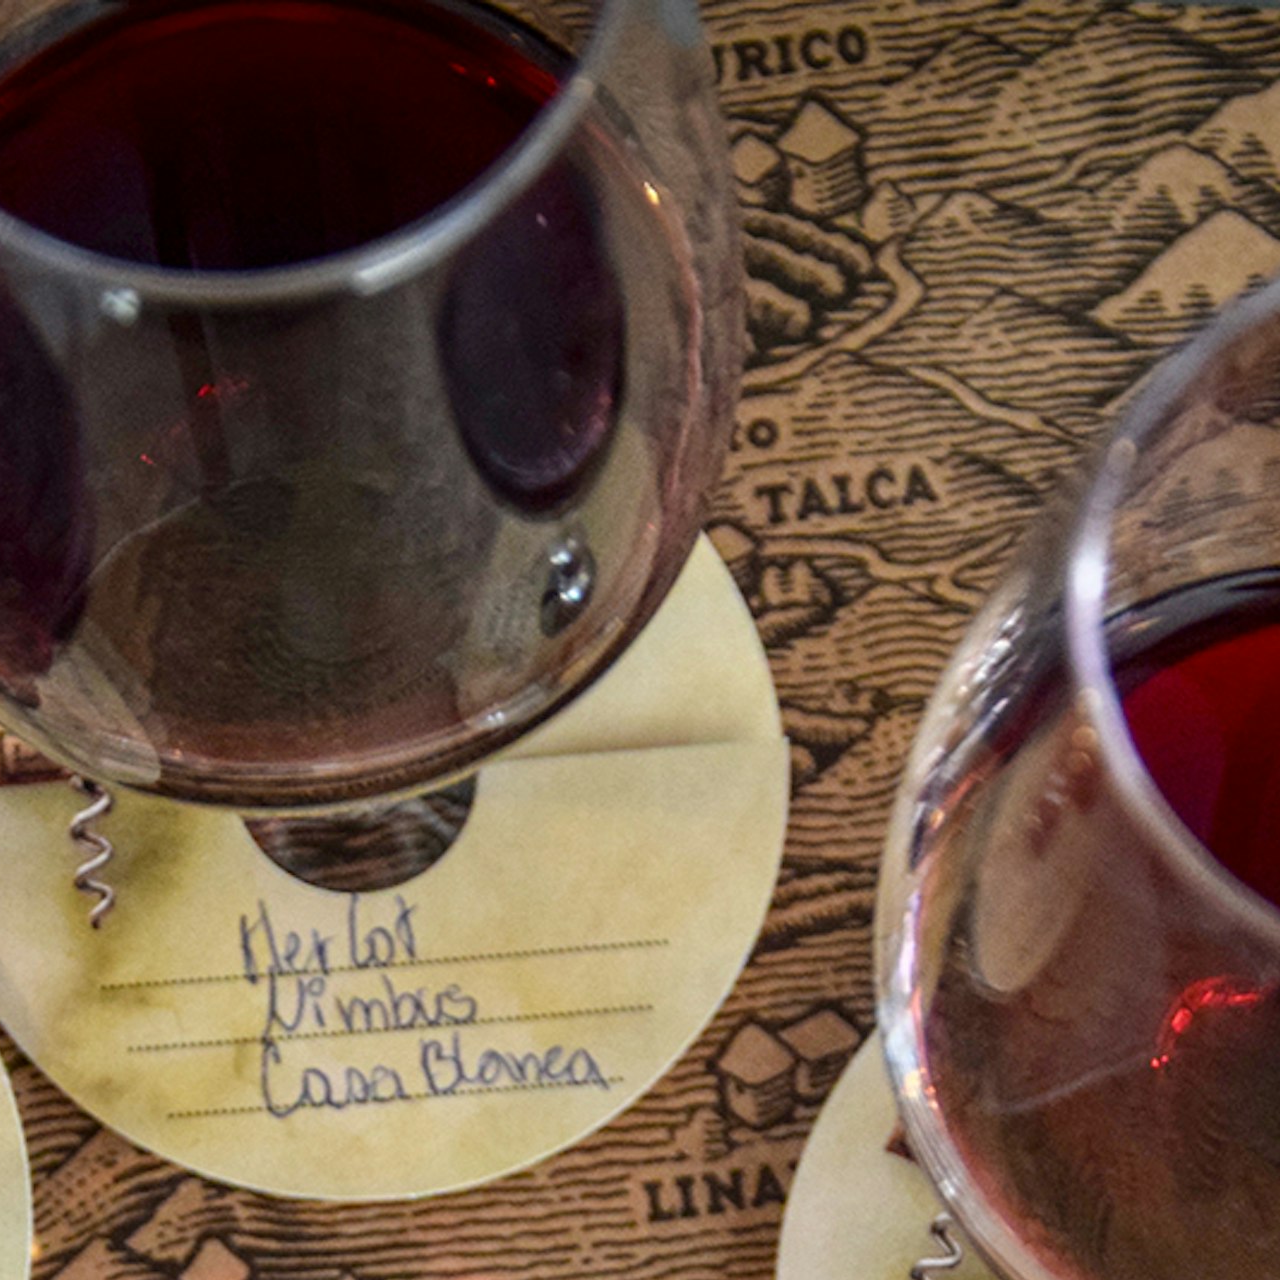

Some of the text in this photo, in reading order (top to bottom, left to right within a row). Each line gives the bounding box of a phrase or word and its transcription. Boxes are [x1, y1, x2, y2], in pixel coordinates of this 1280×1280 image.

[756, 464, 939, 524] TALCA
[240, 893, 418, 985] Merlot
[643, 1160, 797, 1222] LINA
